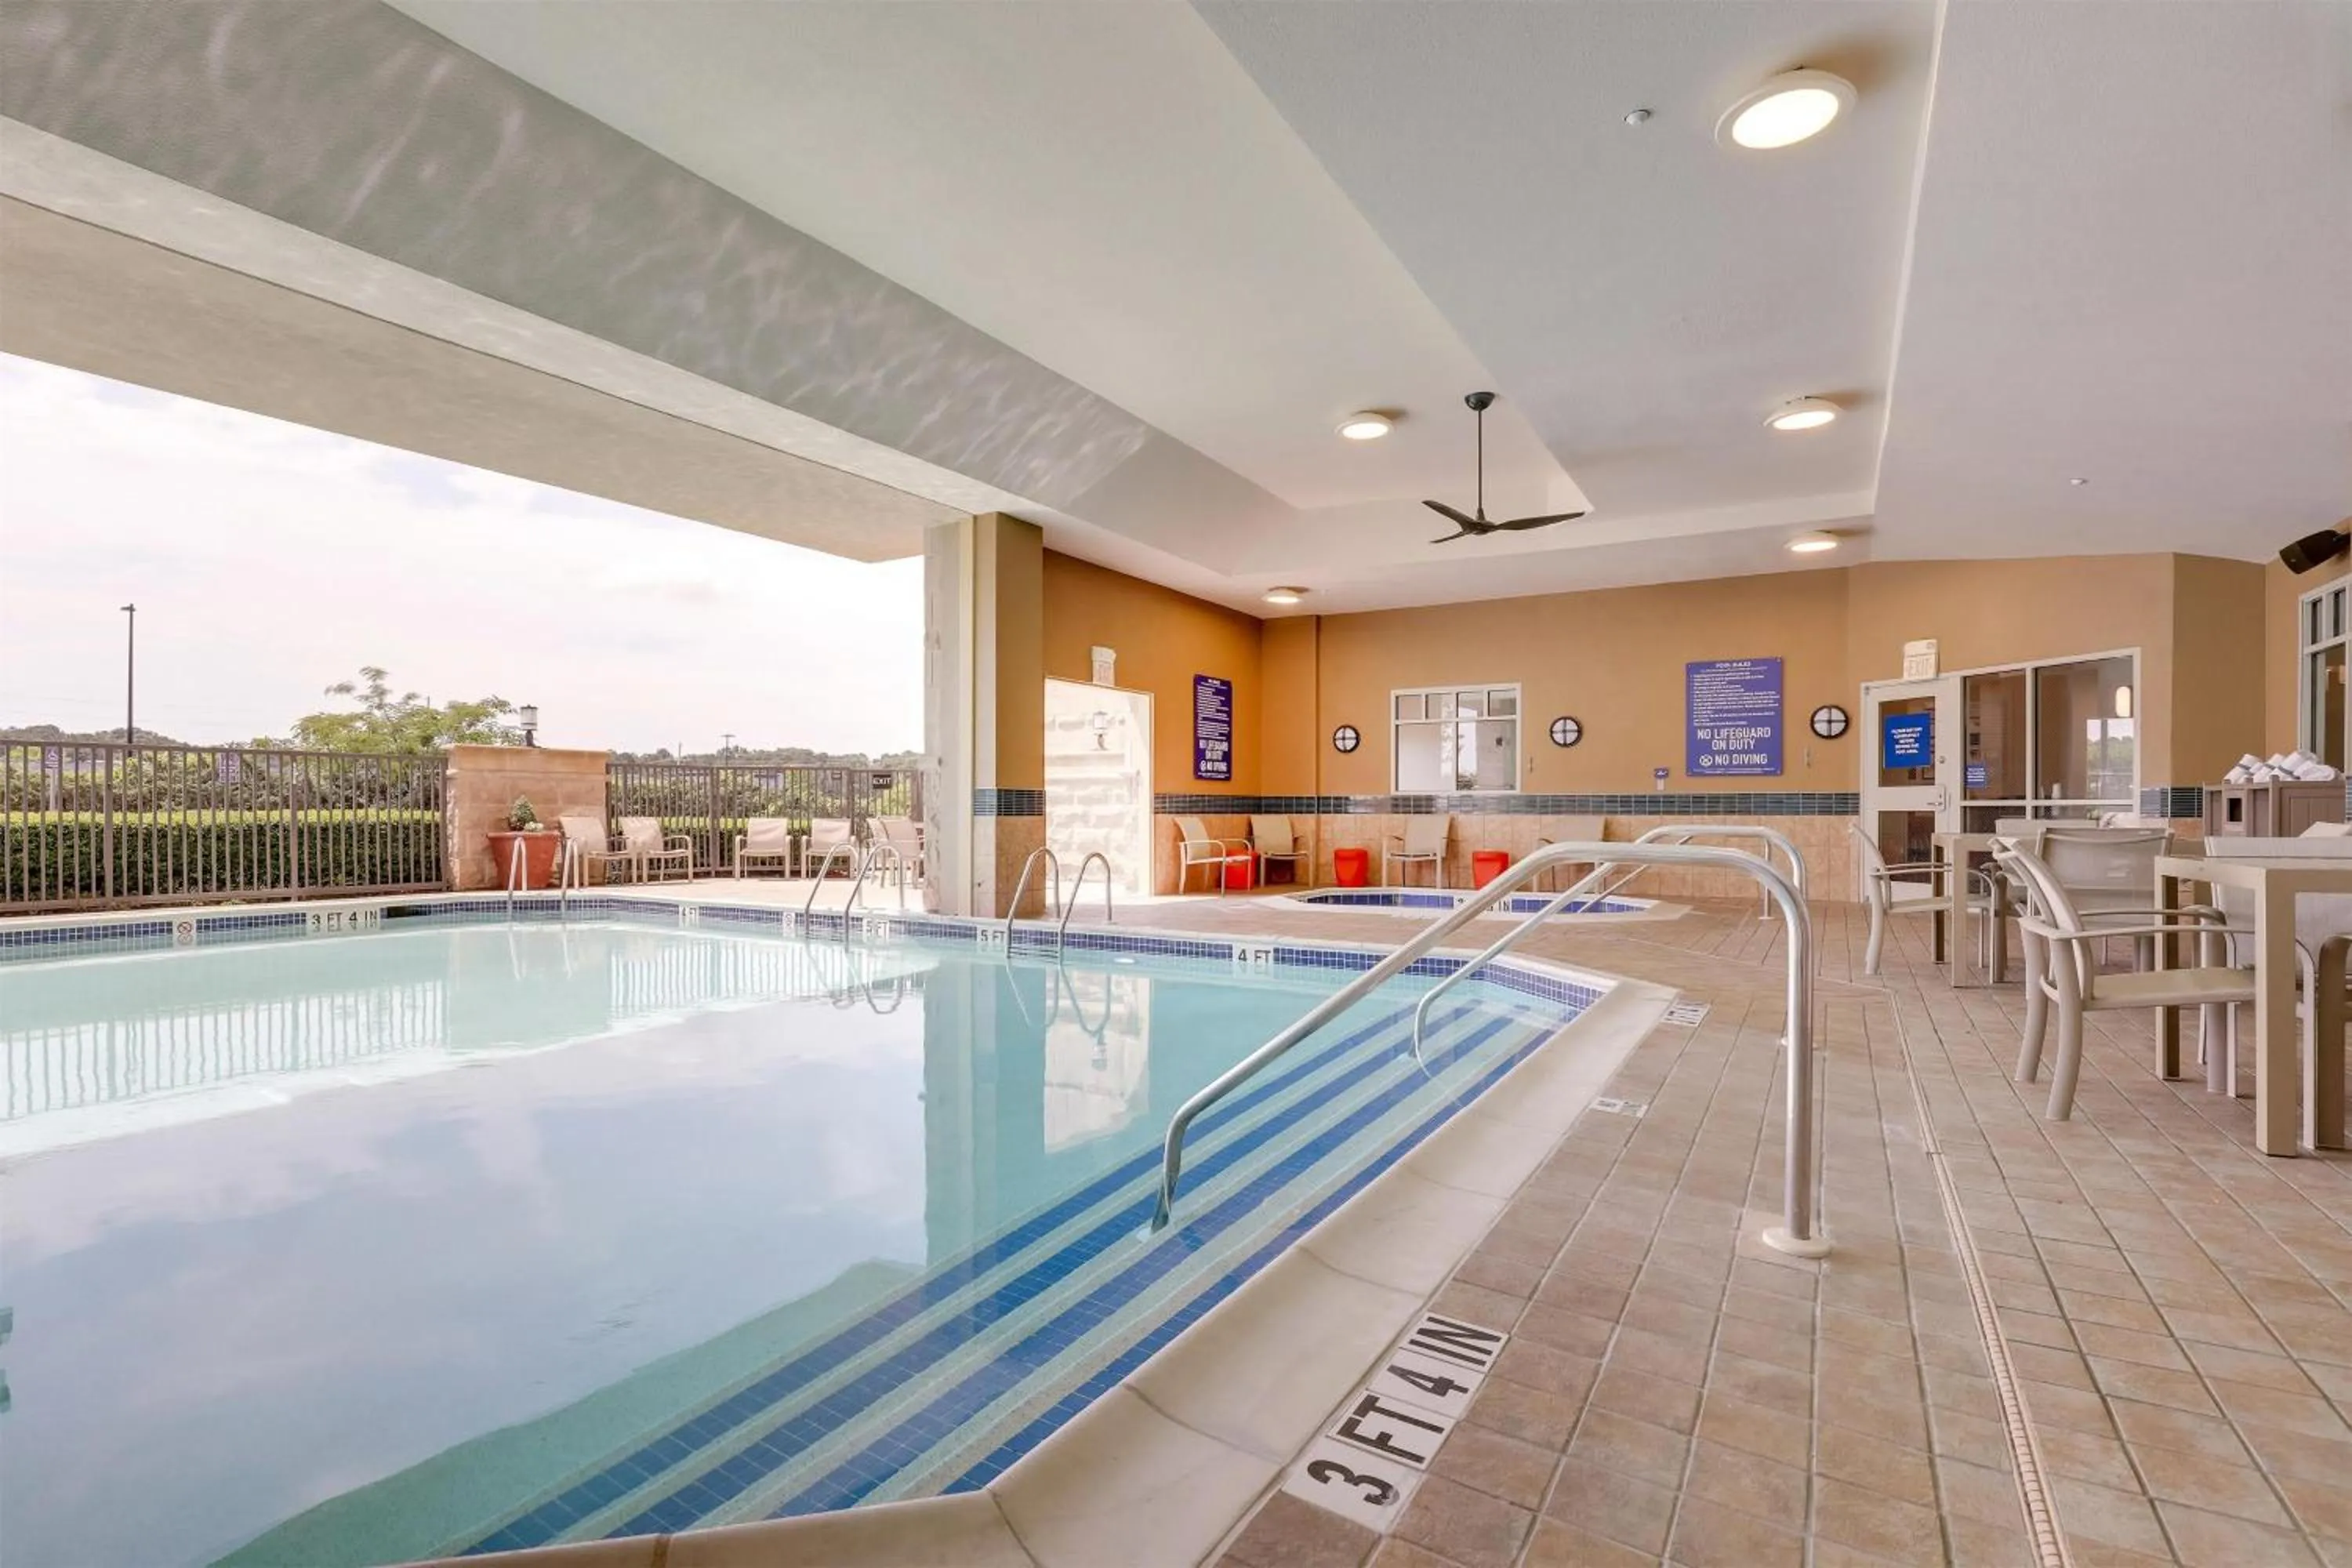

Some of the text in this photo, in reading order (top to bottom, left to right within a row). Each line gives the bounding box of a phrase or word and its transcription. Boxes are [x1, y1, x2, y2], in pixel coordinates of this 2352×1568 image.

[1907, 658, 1932, 677] EXIT
[1697, 727, 1771, 739] NO LIFEGUARD
[1711, 739, 1755, 750] ON DUTY
[1715, 753, 1768, 765] NO DIVING
[311, 910, 377, 924] 3 FT 4 IN
[981, 929, 1005, 942] 5 FT
[1238, 948, 1272, 964] 4 FT
[1307, 1316, 1502, 1506] 3 FT 4 IN
